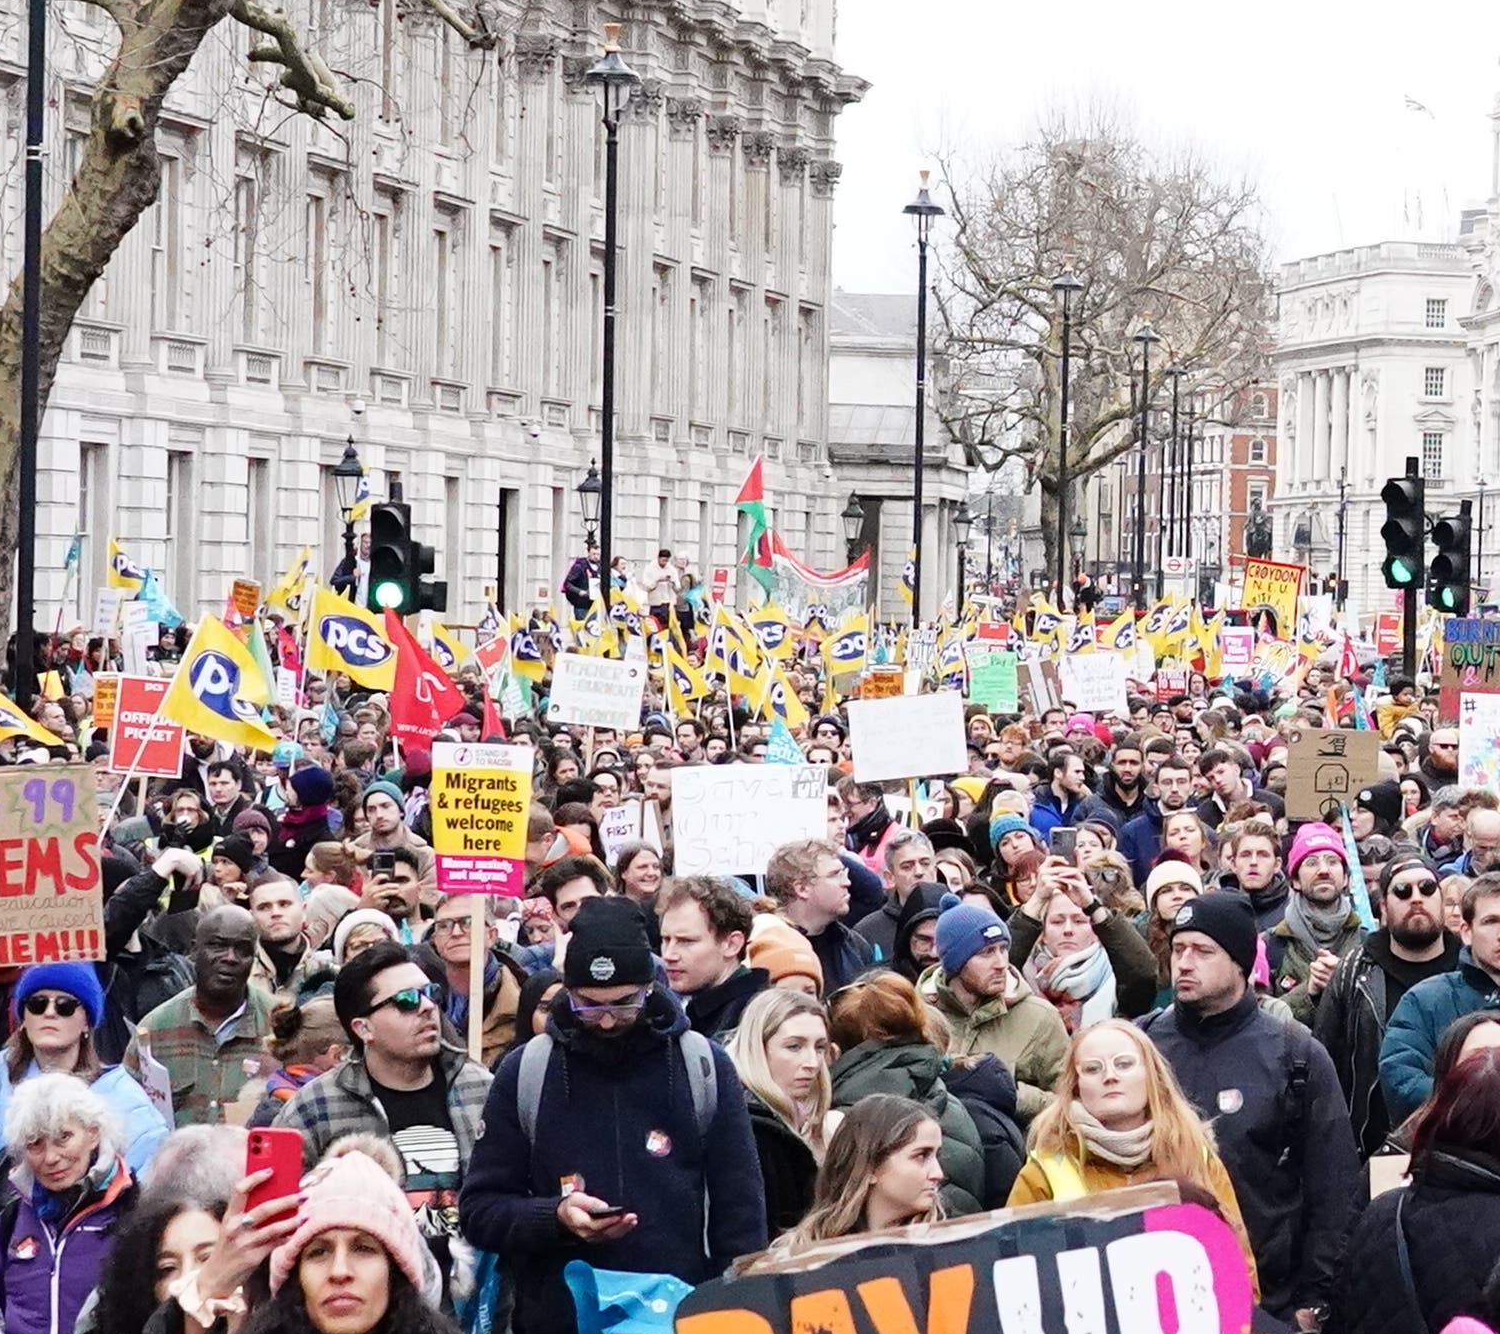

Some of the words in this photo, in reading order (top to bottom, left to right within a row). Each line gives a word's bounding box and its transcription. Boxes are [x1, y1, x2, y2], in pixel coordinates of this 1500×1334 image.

[1249, 565, 1298, 583] CROYDON
[327, 622, 385, 661] pcs
[1452, 644, 1500, 665] OUT
[446, 772, 517, 794] Migrants
[23, 778, 75, 823] 99
[437, 793, 451, 808] &
[455, 793, 522, 812] refugees
[446, 816, 513, 832] welcome
[464, 833, 500, 850] here
